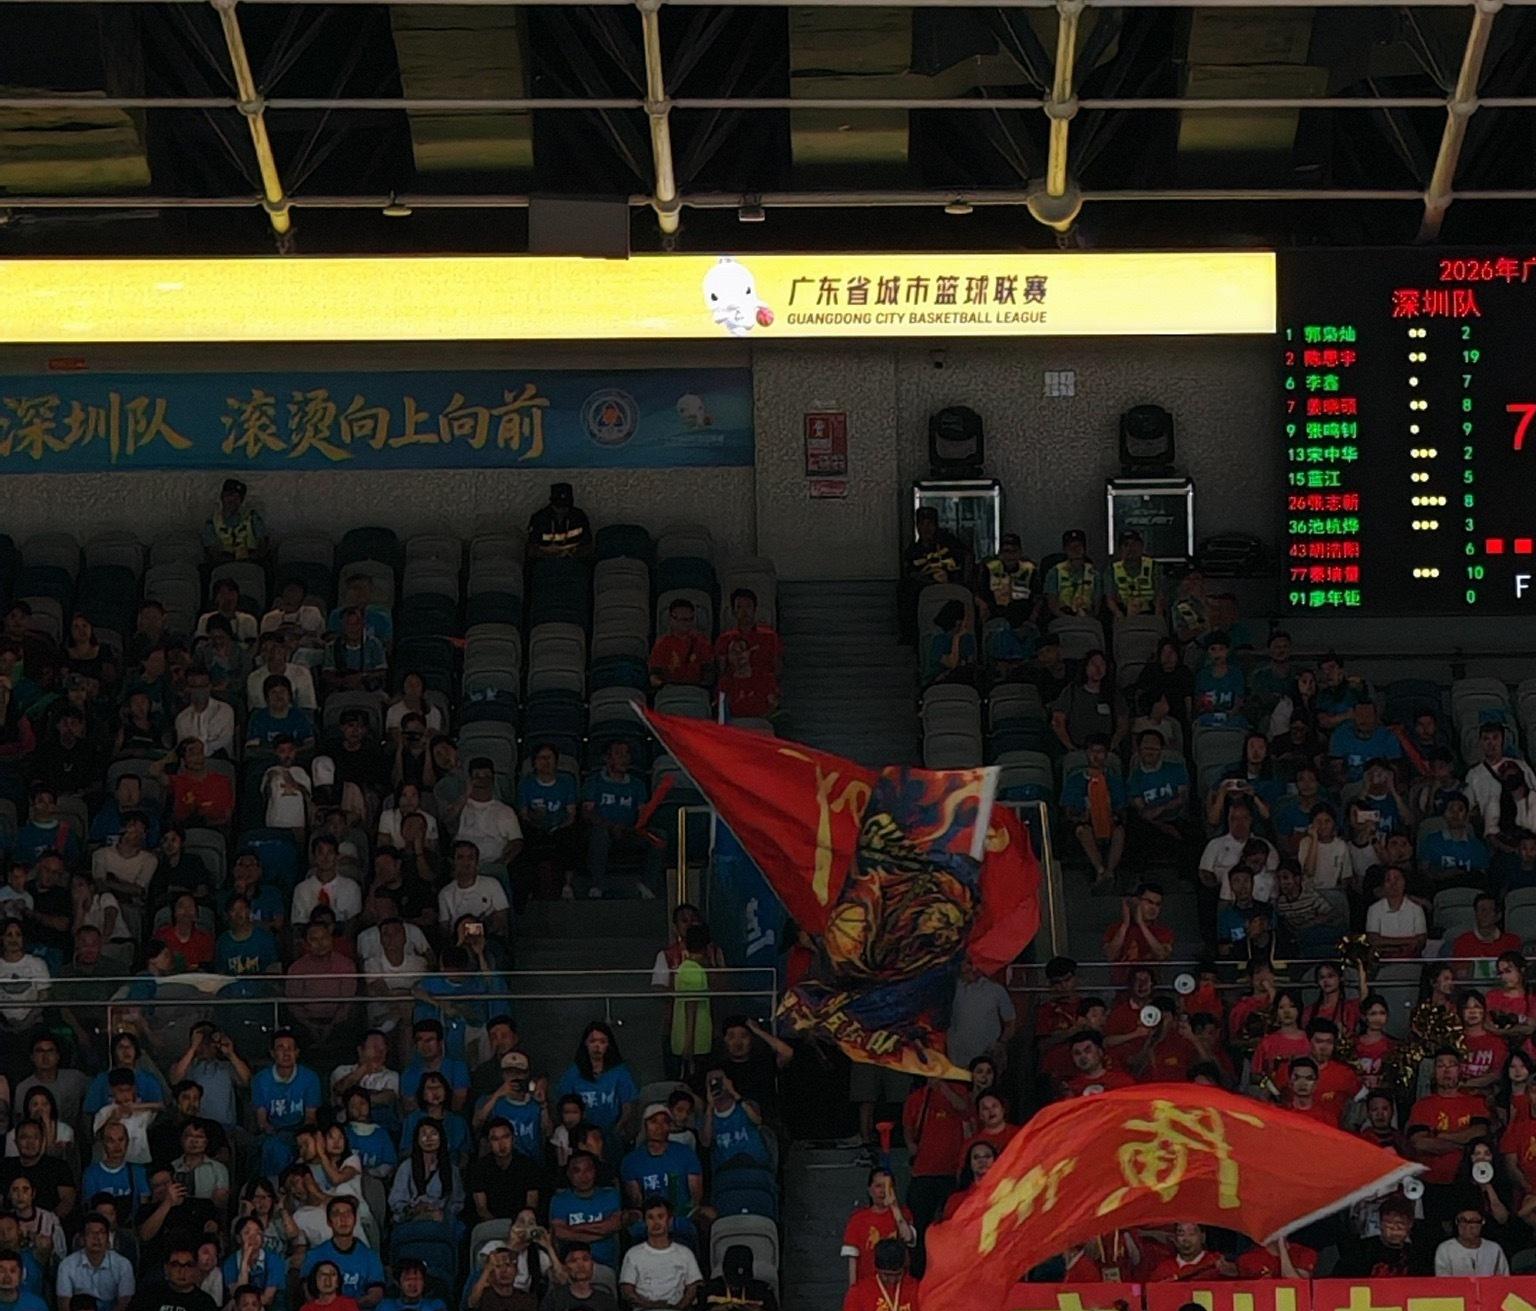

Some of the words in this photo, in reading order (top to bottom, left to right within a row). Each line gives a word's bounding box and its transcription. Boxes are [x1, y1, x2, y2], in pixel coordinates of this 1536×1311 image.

[789, 275, 1049, 306] 广东省城市篮球联赛
[1392, 290, 1481, 318] 深圳队
[787, 312, 872, 325] GUANGDONG
[875, 312, 905, 324] CITY
[909, 311, 992, 324] BASKETBALL
[996, 311, 1047, 323] LEAGUE
[1, 391, 192, 462] 深圳队
[222, 384, 550, 461] 滚烫向上向前
